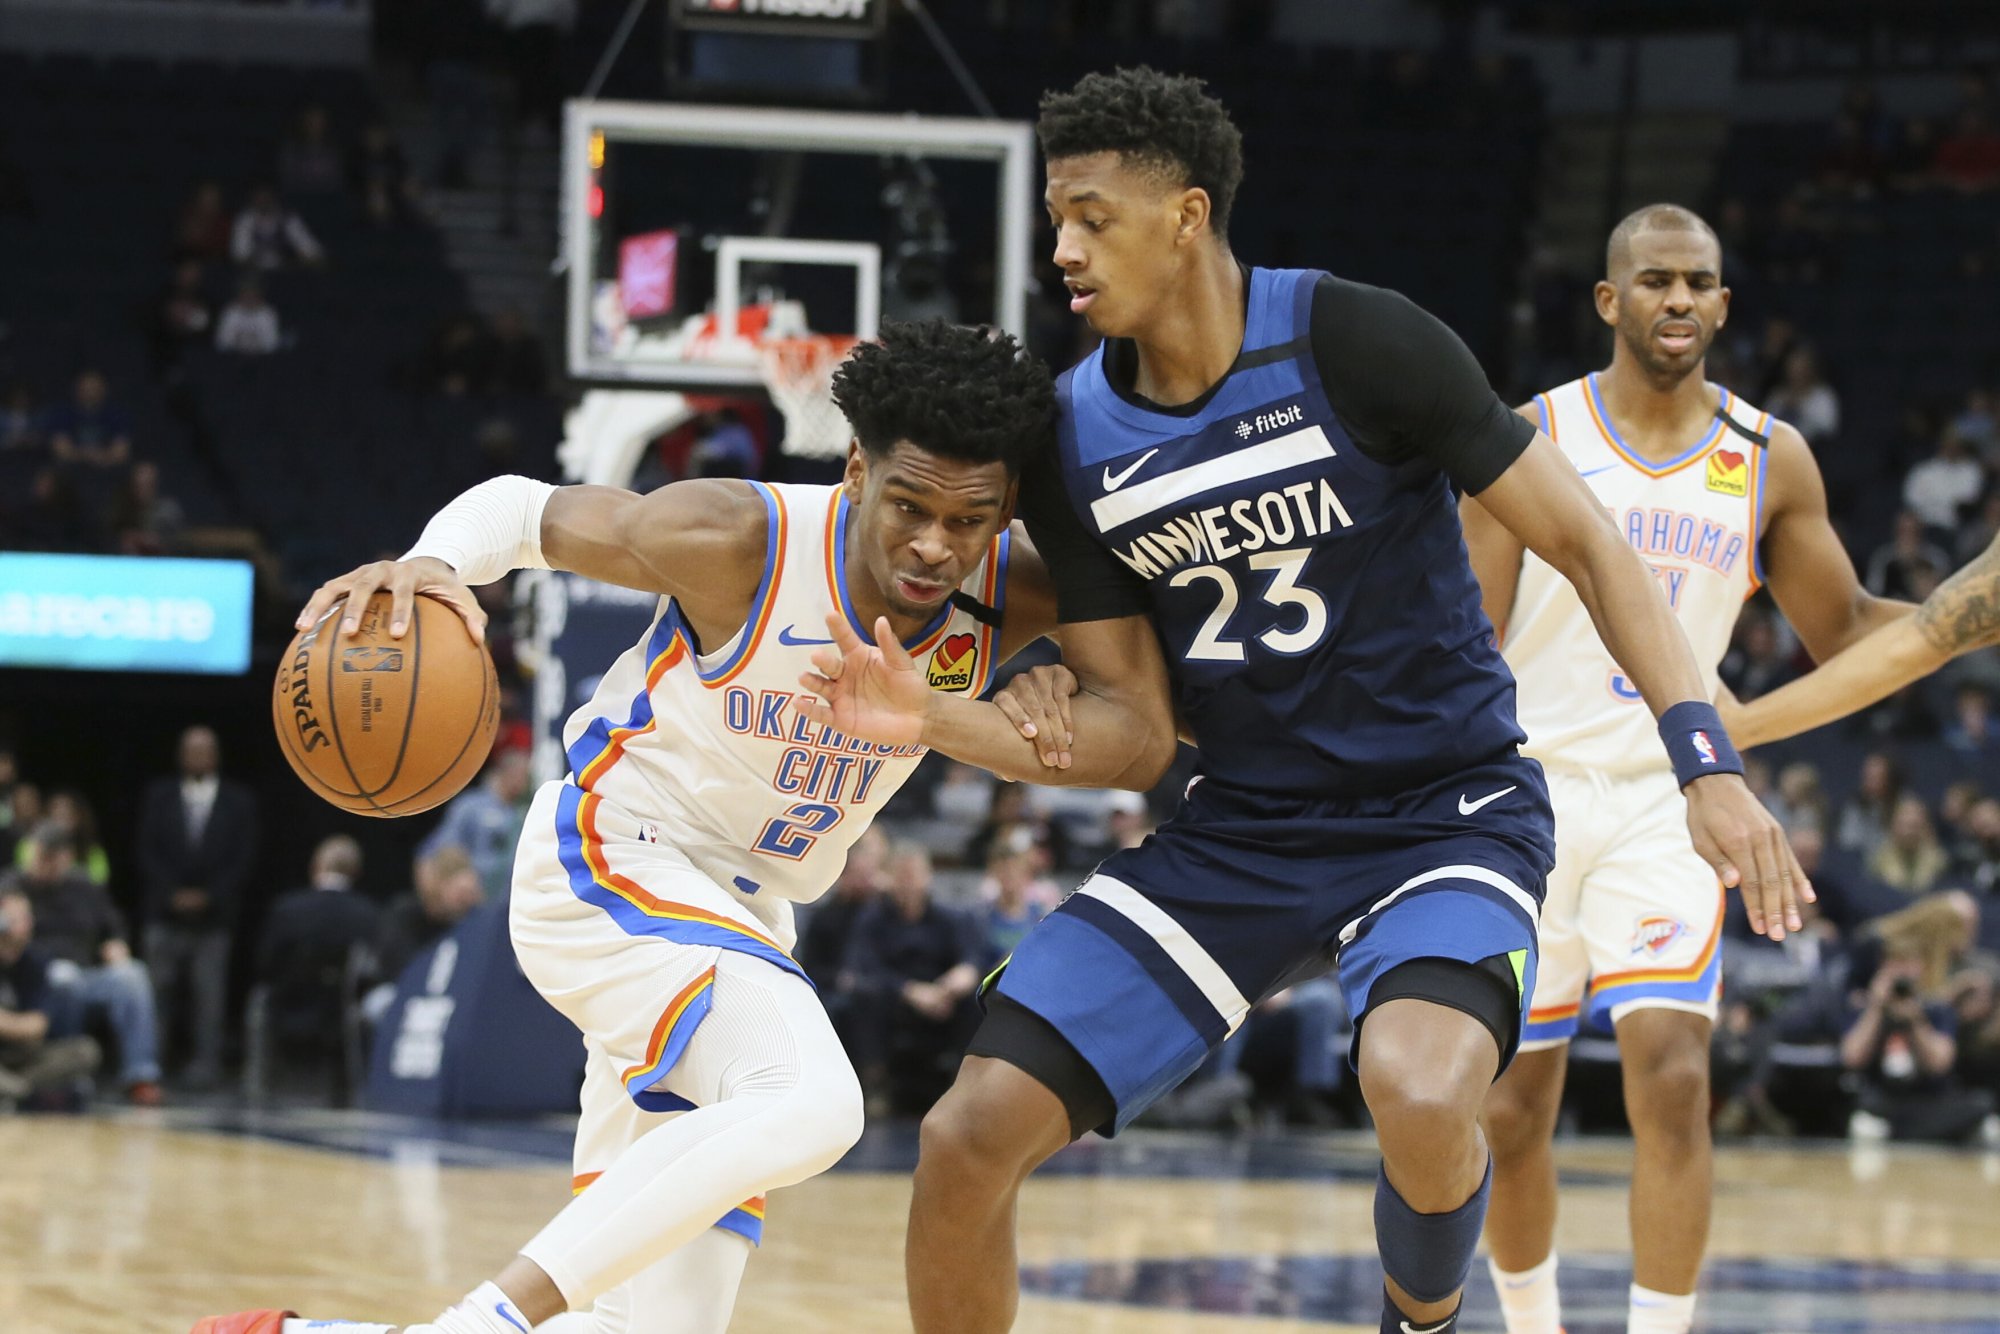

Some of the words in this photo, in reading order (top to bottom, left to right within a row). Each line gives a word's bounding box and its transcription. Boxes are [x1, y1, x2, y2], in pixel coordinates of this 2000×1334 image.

[1255, 404, 1304, 434] fitbit
[1110, 477, 1354, 581] MINNESOTA
[1603, 506, 1746, 578] AHOMA
[1168, 547, 1329, 662] 23
[773, 746, 885, 805] CITY
[750, 802, 845, 862] 2
